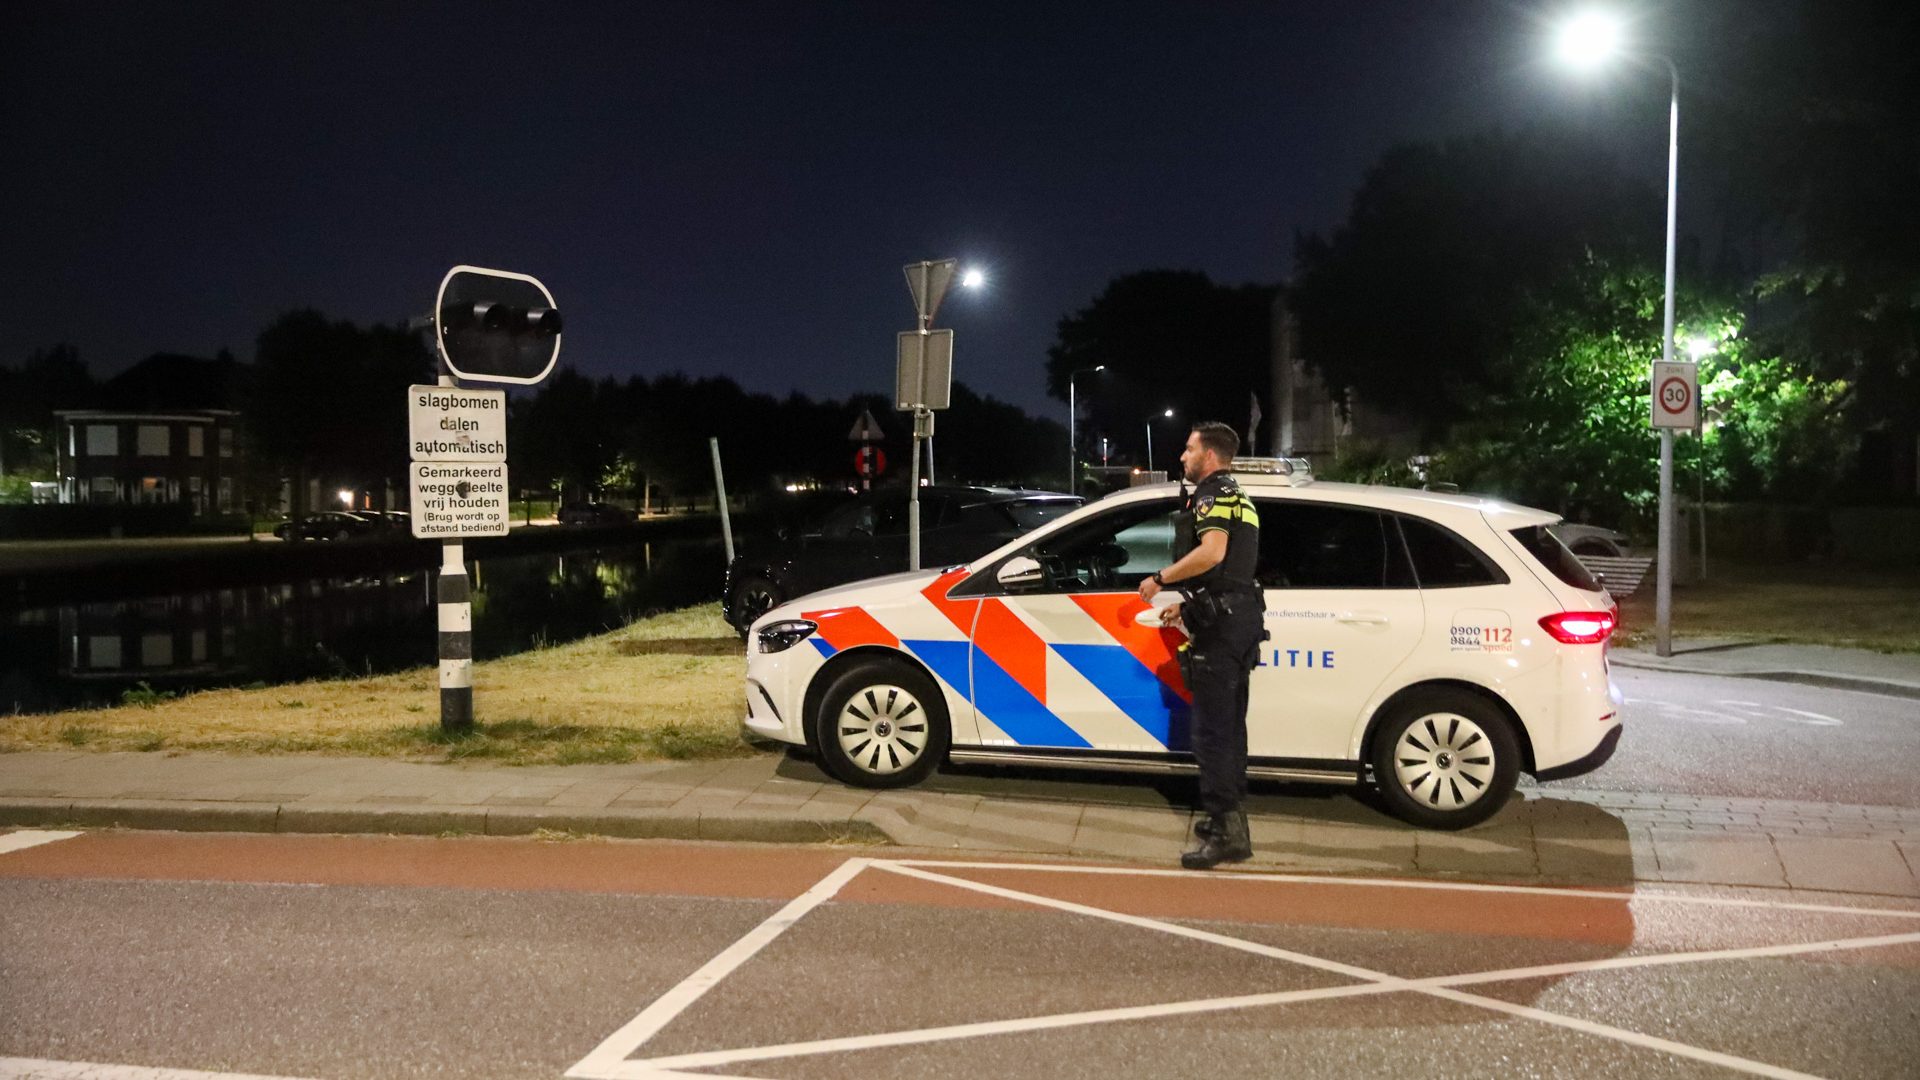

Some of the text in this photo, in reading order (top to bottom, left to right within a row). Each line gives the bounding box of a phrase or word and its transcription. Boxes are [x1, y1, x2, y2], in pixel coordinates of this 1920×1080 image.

[419, 393, 499, 411] slagbomen
[1665, 388, 1685, 402] 30
[440, 417, 479, 431] dalen
[415, 440, 504, 455] automatisch
[419, 466, 501, 478] Gemarkeerd
[418, 481, 503, 496] weggdeelte
[423, 496, 500, 511] vrij houden
[424, 512, 500, 523] (Brug wordt op
[420, 522, 505, 533] afstand bediend)
[1450, 626, 1480, 636] 0900
[1484, 627, 1512, 643] 112
